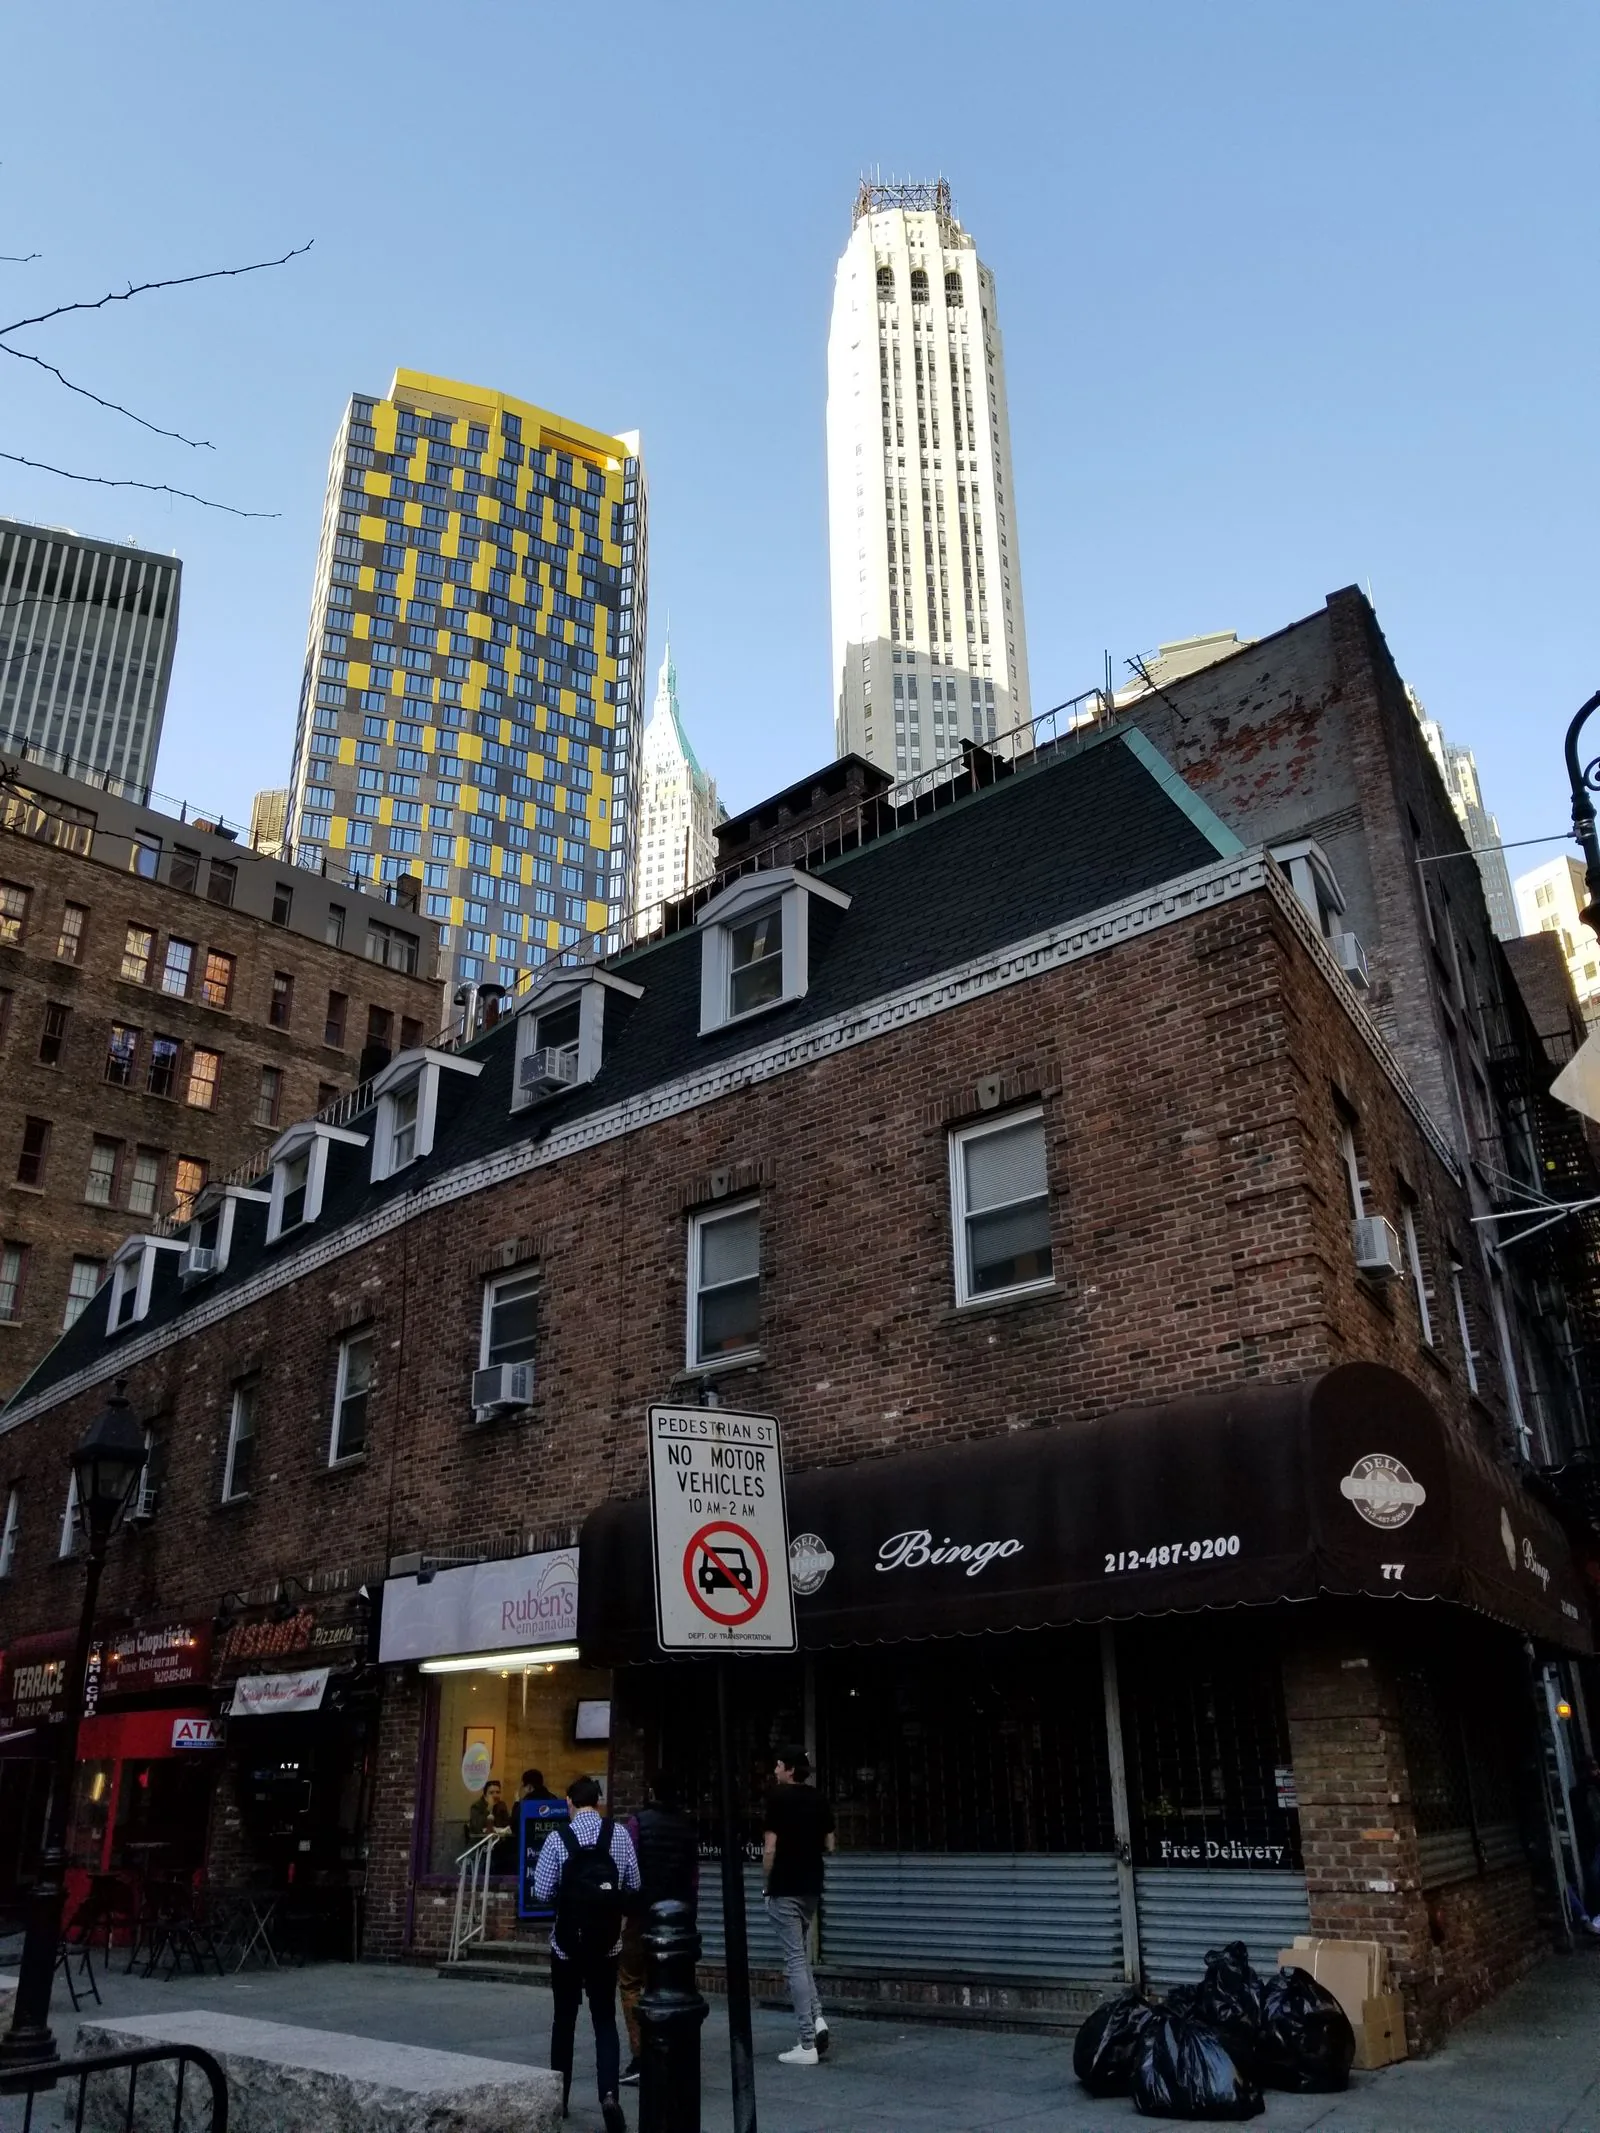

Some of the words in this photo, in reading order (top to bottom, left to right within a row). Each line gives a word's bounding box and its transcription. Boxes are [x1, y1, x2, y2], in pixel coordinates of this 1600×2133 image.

[658, 1417, 751, 1438] PEDESTRIAN
[756, 1427, 773, 1441] ST
[667, 1444, 693, 1466] NO
[711, 1447, 766, 1472] MOTOR
[1361, 1458, 1401, 1474] DELI
[677, 1471, 765, 1498] VEHICLES
[1352, 1482, 1416, 1501] BINGO
[689, 1498, 702, 1513] 10
[742, 1504, 756, 1517] AM
[793, 1536, 819, 1552] DELI
[874, 1529, 1024, 1577] Bingo
[1104, 1534, 1241, 1573] 212-487-9200
[1380, 1564, 1406, 1580] 77
[501, 1587, 575, 1631] Ruben's
[314, 1625, 355, 1646] Pizzeria
[515, 1612, 576, 1637] empanadas
[687, 1632, 707, 1640] DEPT.
[719, 1633, 772, 1641] TRANSPORTATION
[13, 1659, 66, 1701] TERRACE
[177, 1721, 226, 1740] ATM
[279, 1762, 300, 1770] ATM
[1159, 1840, 1201, 1860] Free
[1205, 1840, 1285, 1865] Delivery
